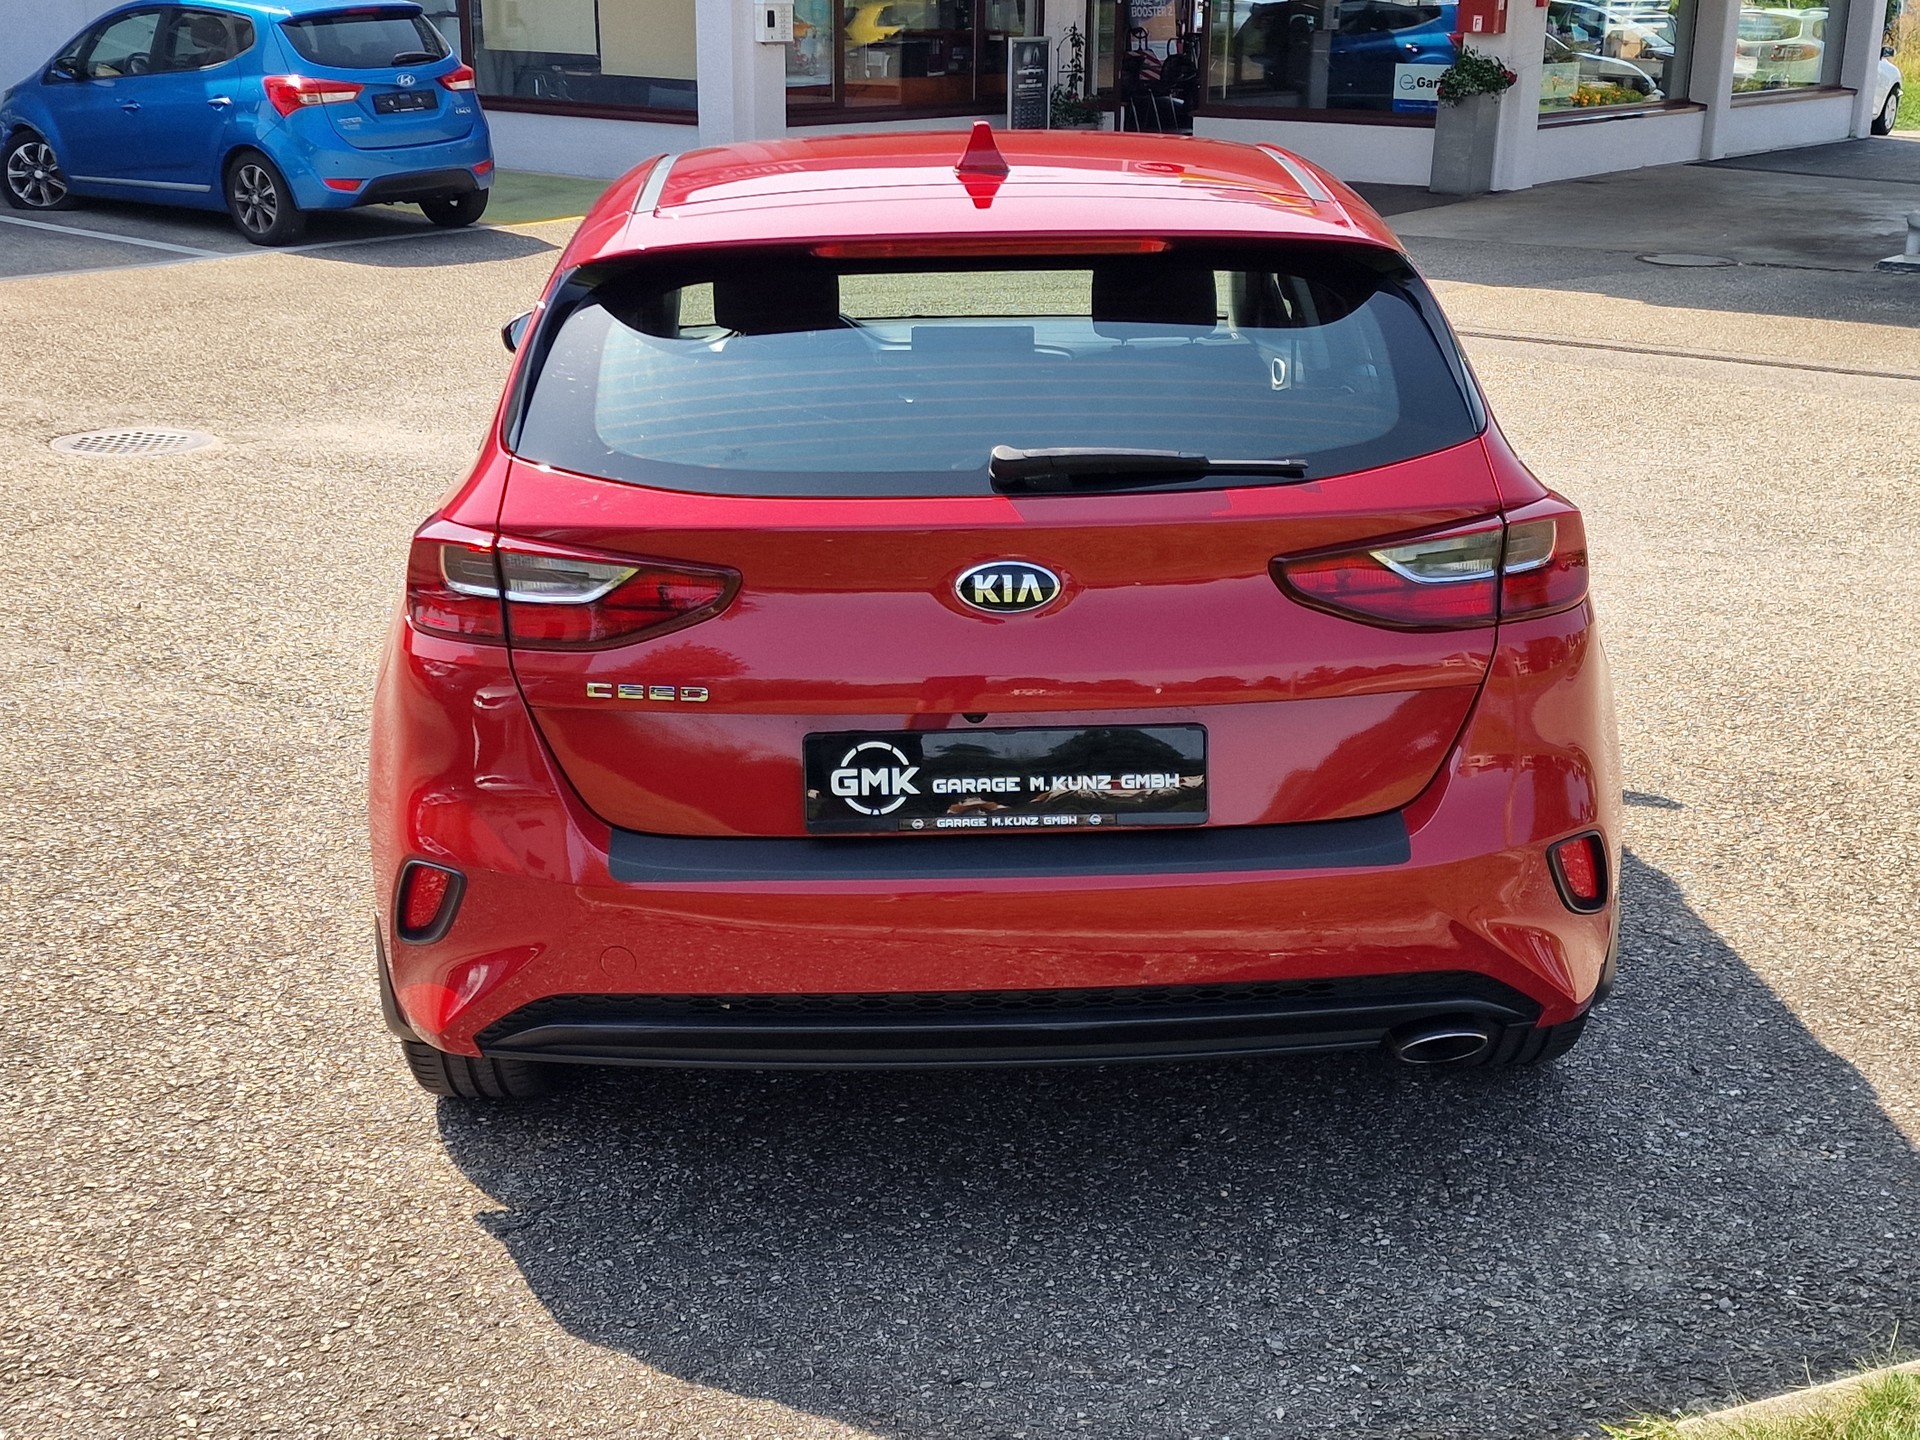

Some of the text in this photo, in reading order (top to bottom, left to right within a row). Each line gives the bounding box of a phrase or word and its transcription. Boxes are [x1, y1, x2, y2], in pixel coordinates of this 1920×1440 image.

[1131, 6, 1174, 17] BOOSTER 2
[973, 573, 1044, 603] KIA
[586, 682, 709, 702] CEED
[830, 766, 921, 796] GMK
[932, 773, 1180, 794] GARAGE M.KUNZ GMBH
[936, 815, 1078, 828] GARAGE M.KUNZ GMBH
